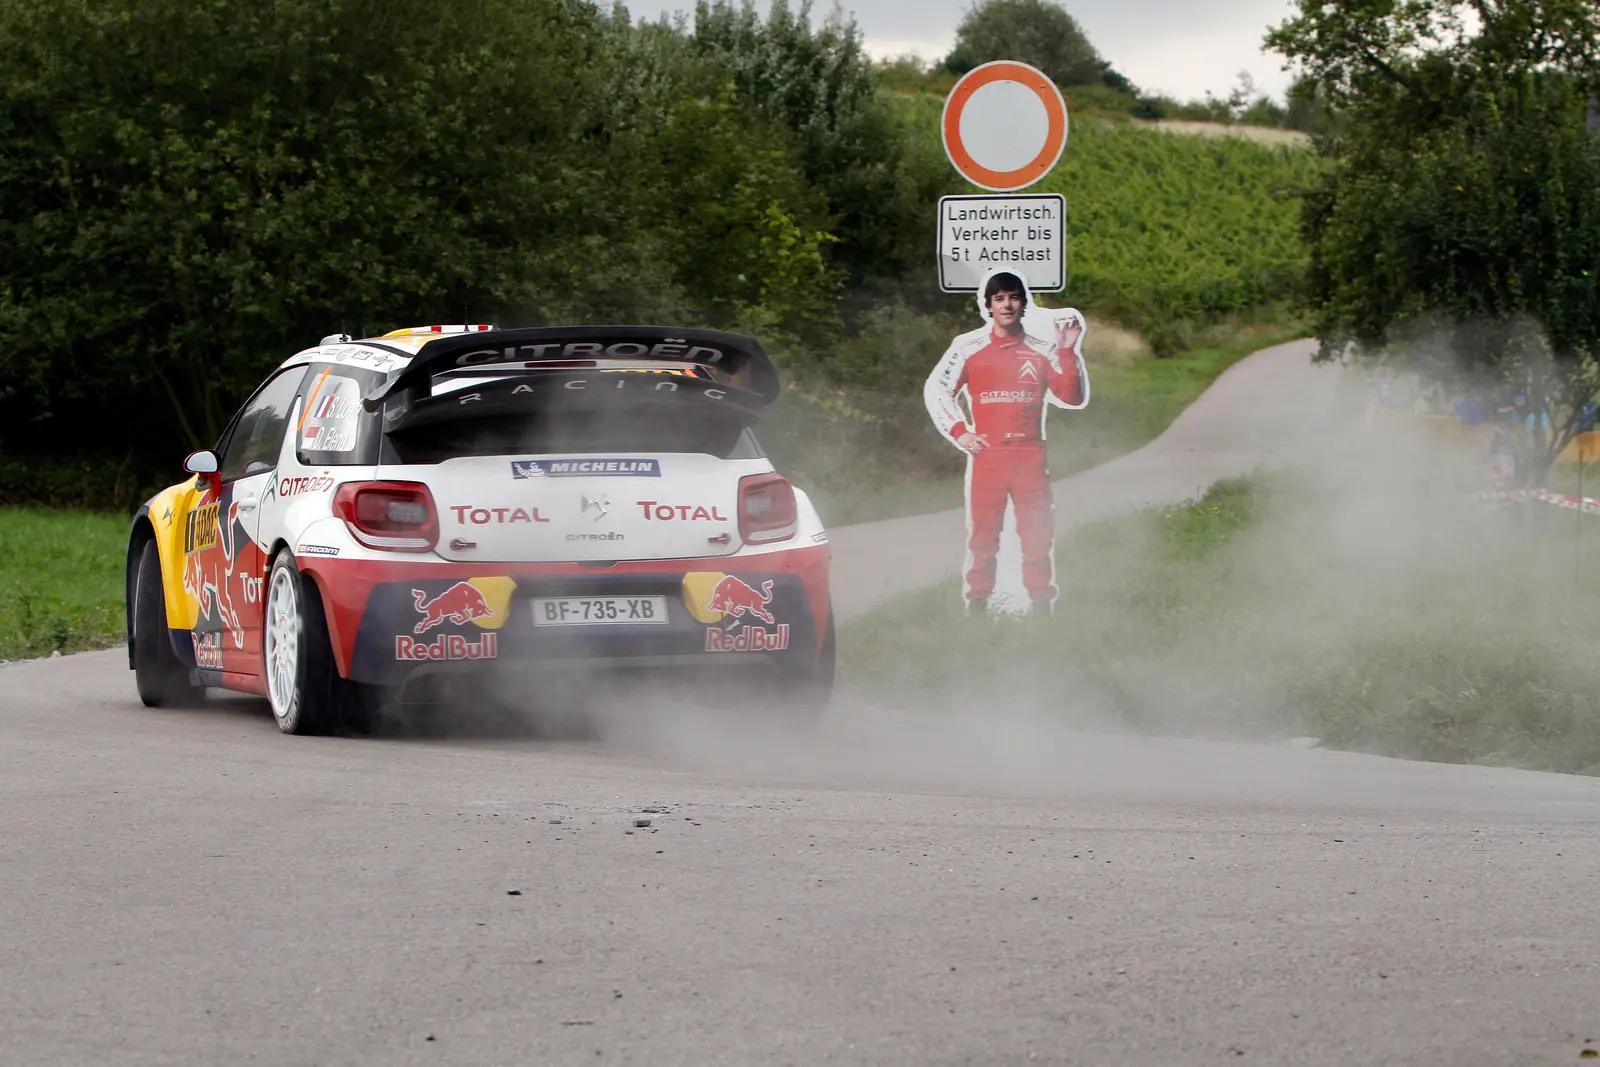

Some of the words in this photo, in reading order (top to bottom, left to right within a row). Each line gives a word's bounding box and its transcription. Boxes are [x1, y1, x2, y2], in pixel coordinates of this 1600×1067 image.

[948, 205, 1056, 221] Landwirtsch.
[952, 227, 1019, 241] Verkehr
[1027, 226, 1052, 240] bis
[951, 248, 961, 262] 5
[964, 248, 970, 262] t
[978, 247, 1051, 261] Achslast
[550, 462, 652, 473] MICHELIN
[544, 600, 655, 621] BF-735-XB
